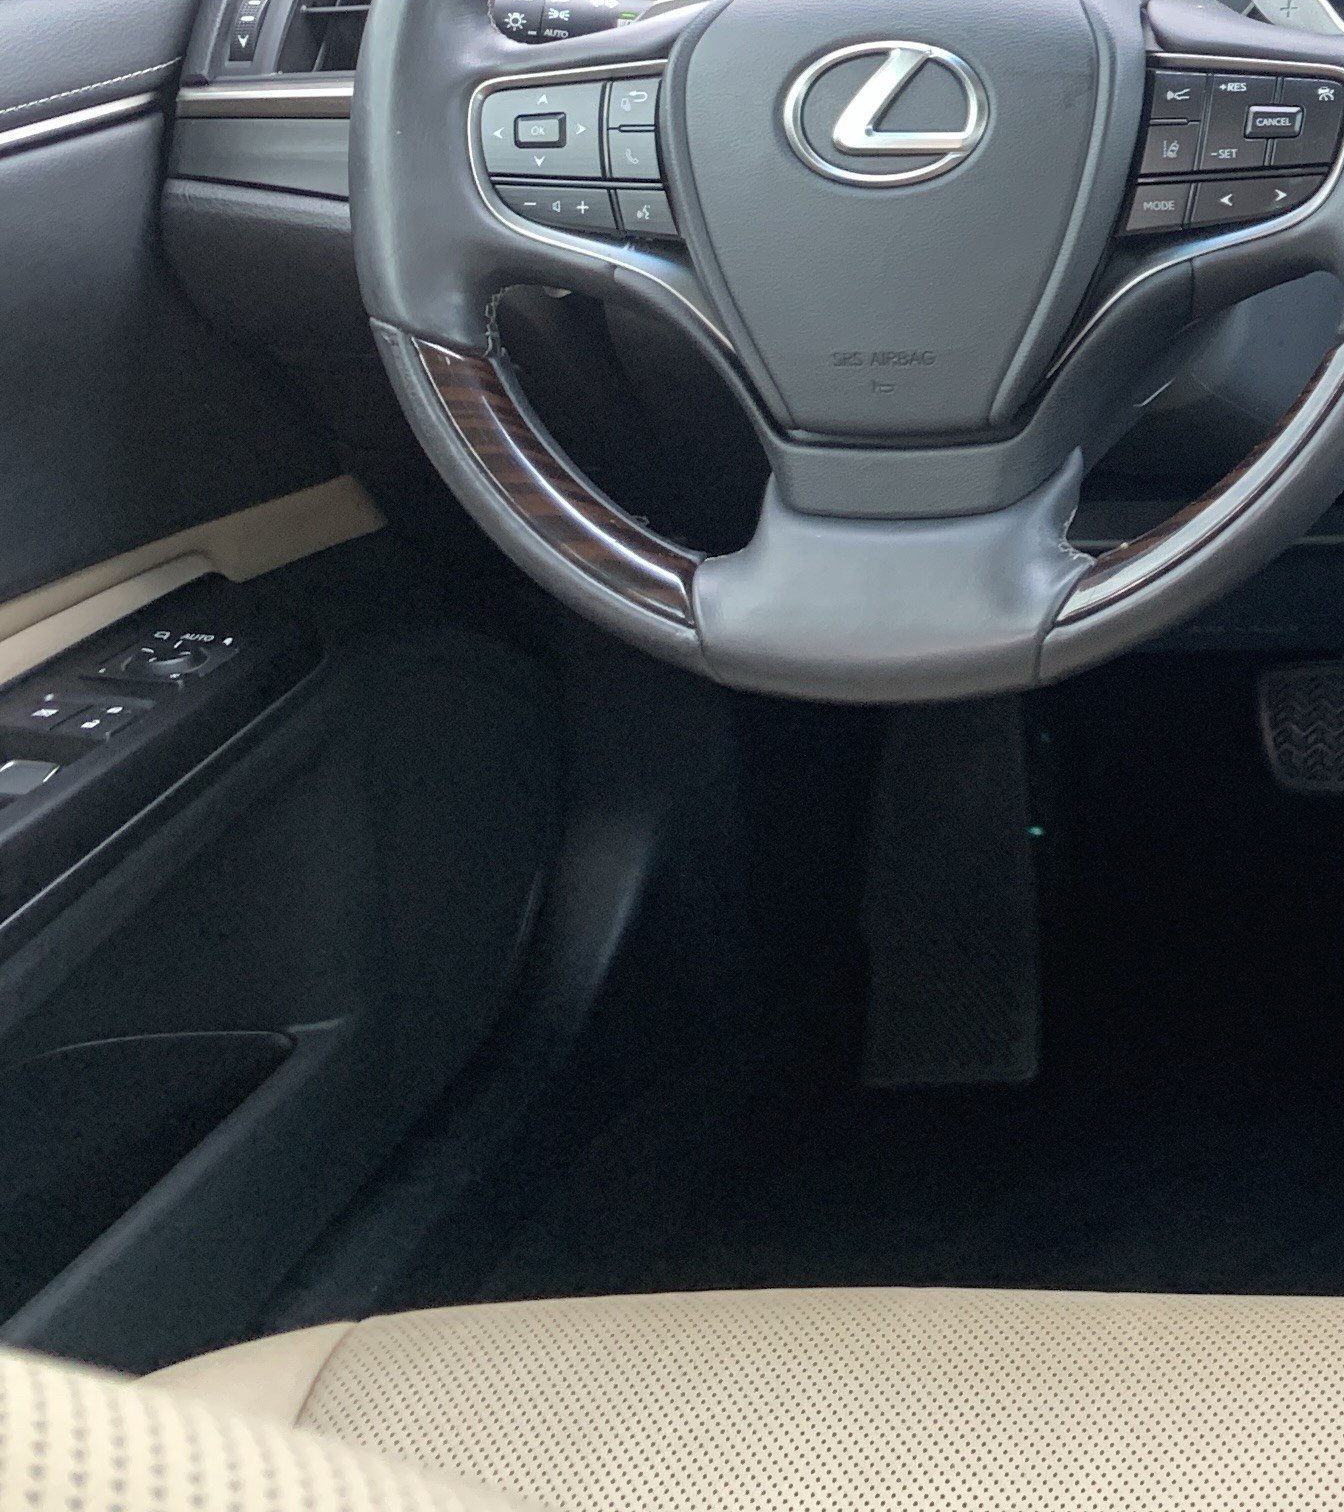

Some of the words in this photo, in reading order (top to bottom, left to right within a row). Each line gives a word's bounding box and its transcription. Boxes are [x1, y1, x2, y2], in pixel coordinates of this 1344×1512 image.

[543, 29, 569, 38] AUTO
[1255, 117, 1292, 128] CANCEL
[530, 125, 546, 136] OK
[1143, 200, 1176, 211] MODE
[870, 351, 936, 367] AIRBAG
[181, 633, 214, 642] AUTO
